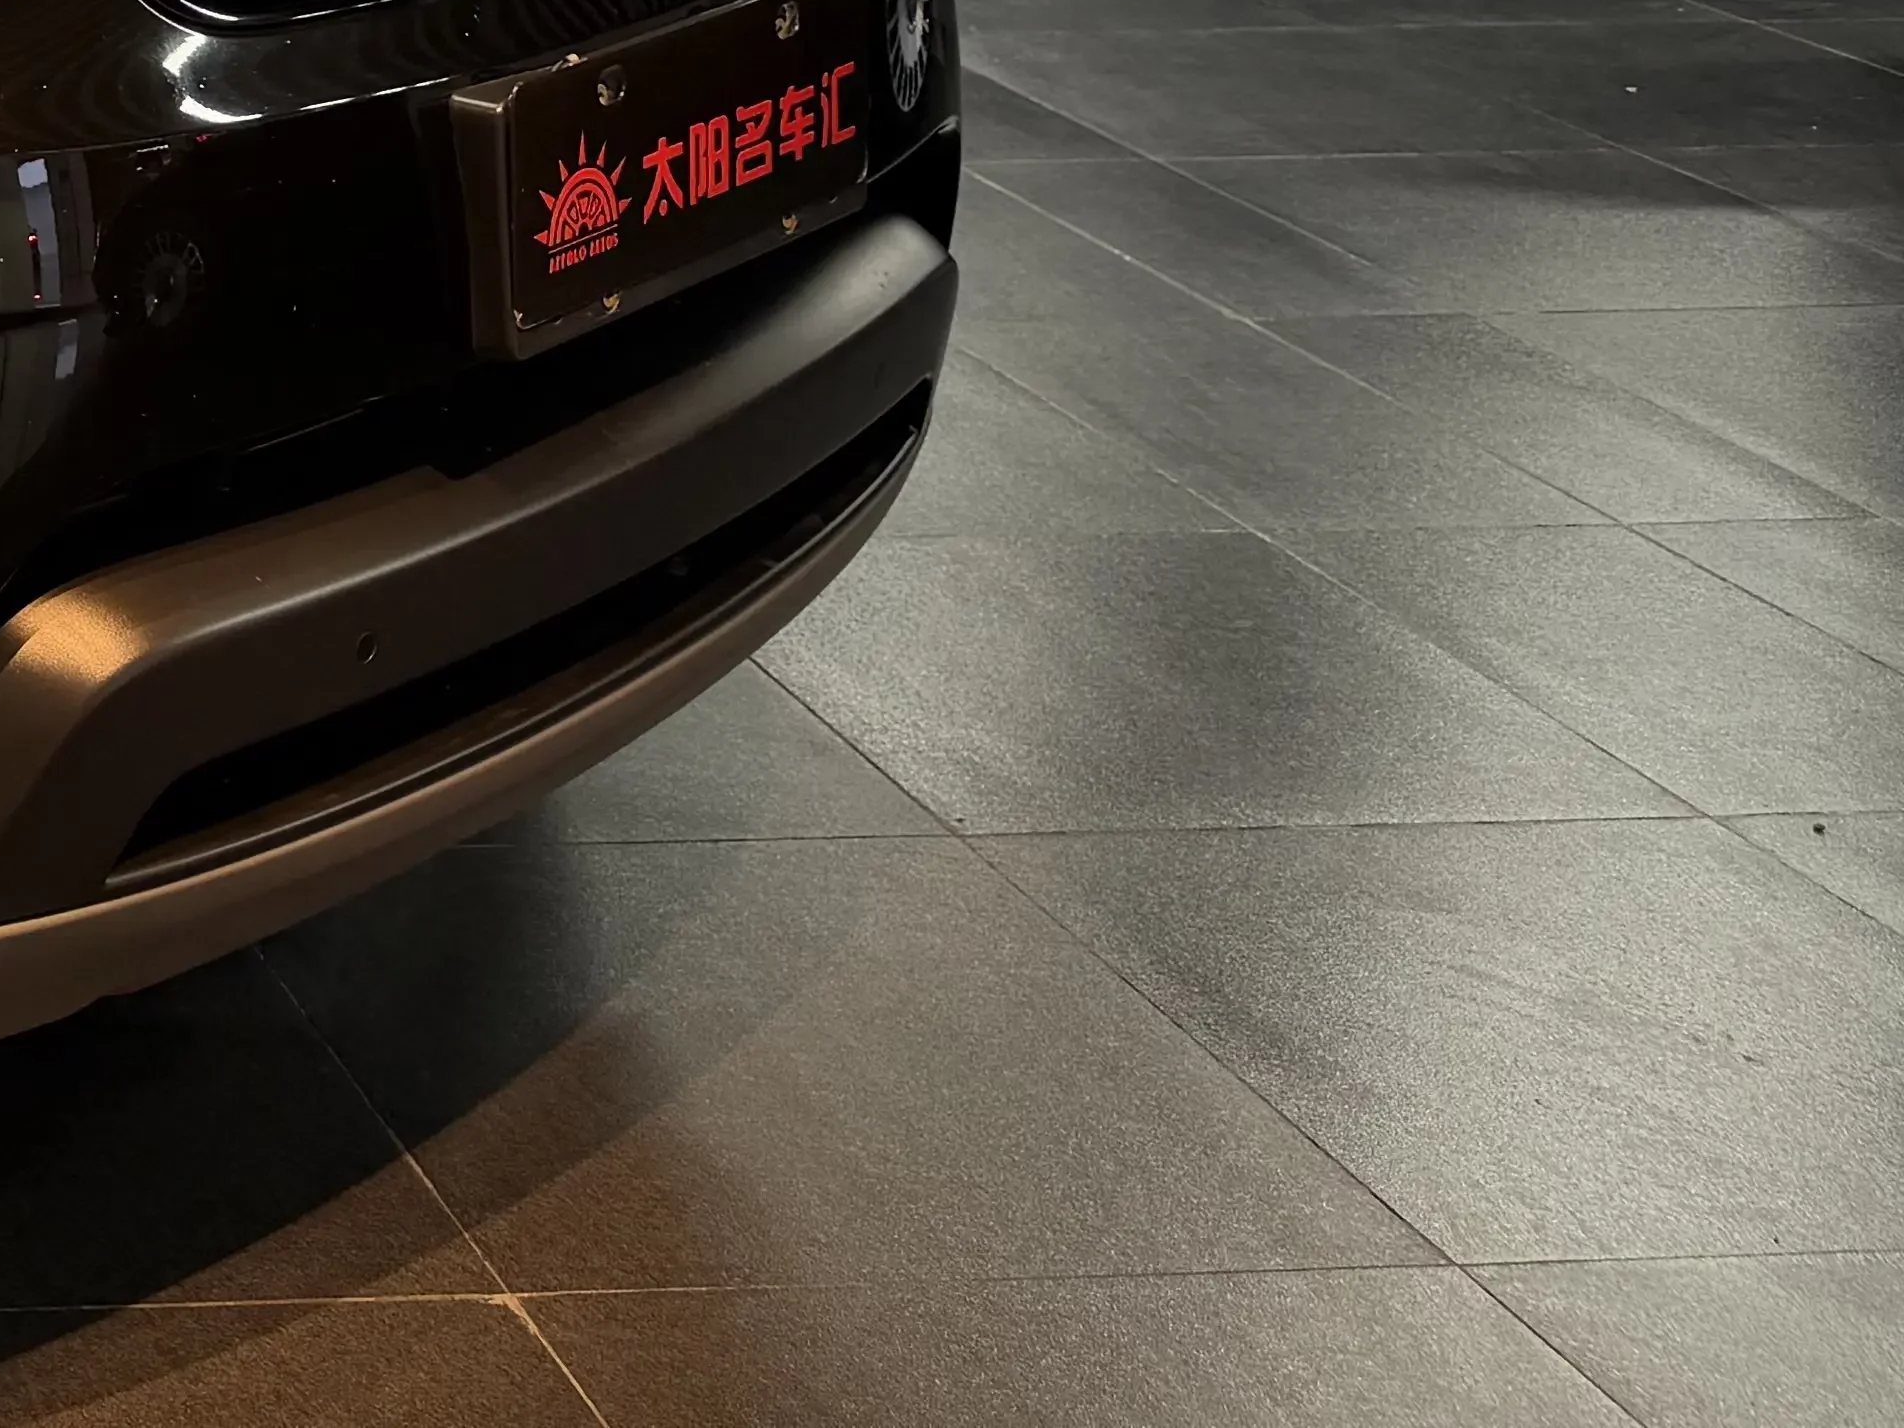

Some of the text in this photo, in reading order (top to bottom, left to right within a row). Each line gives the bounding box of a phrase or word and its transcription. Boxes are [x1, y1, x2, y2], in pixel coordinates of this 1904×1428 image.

[642, 60, 857, 225] 太阳名车汇
